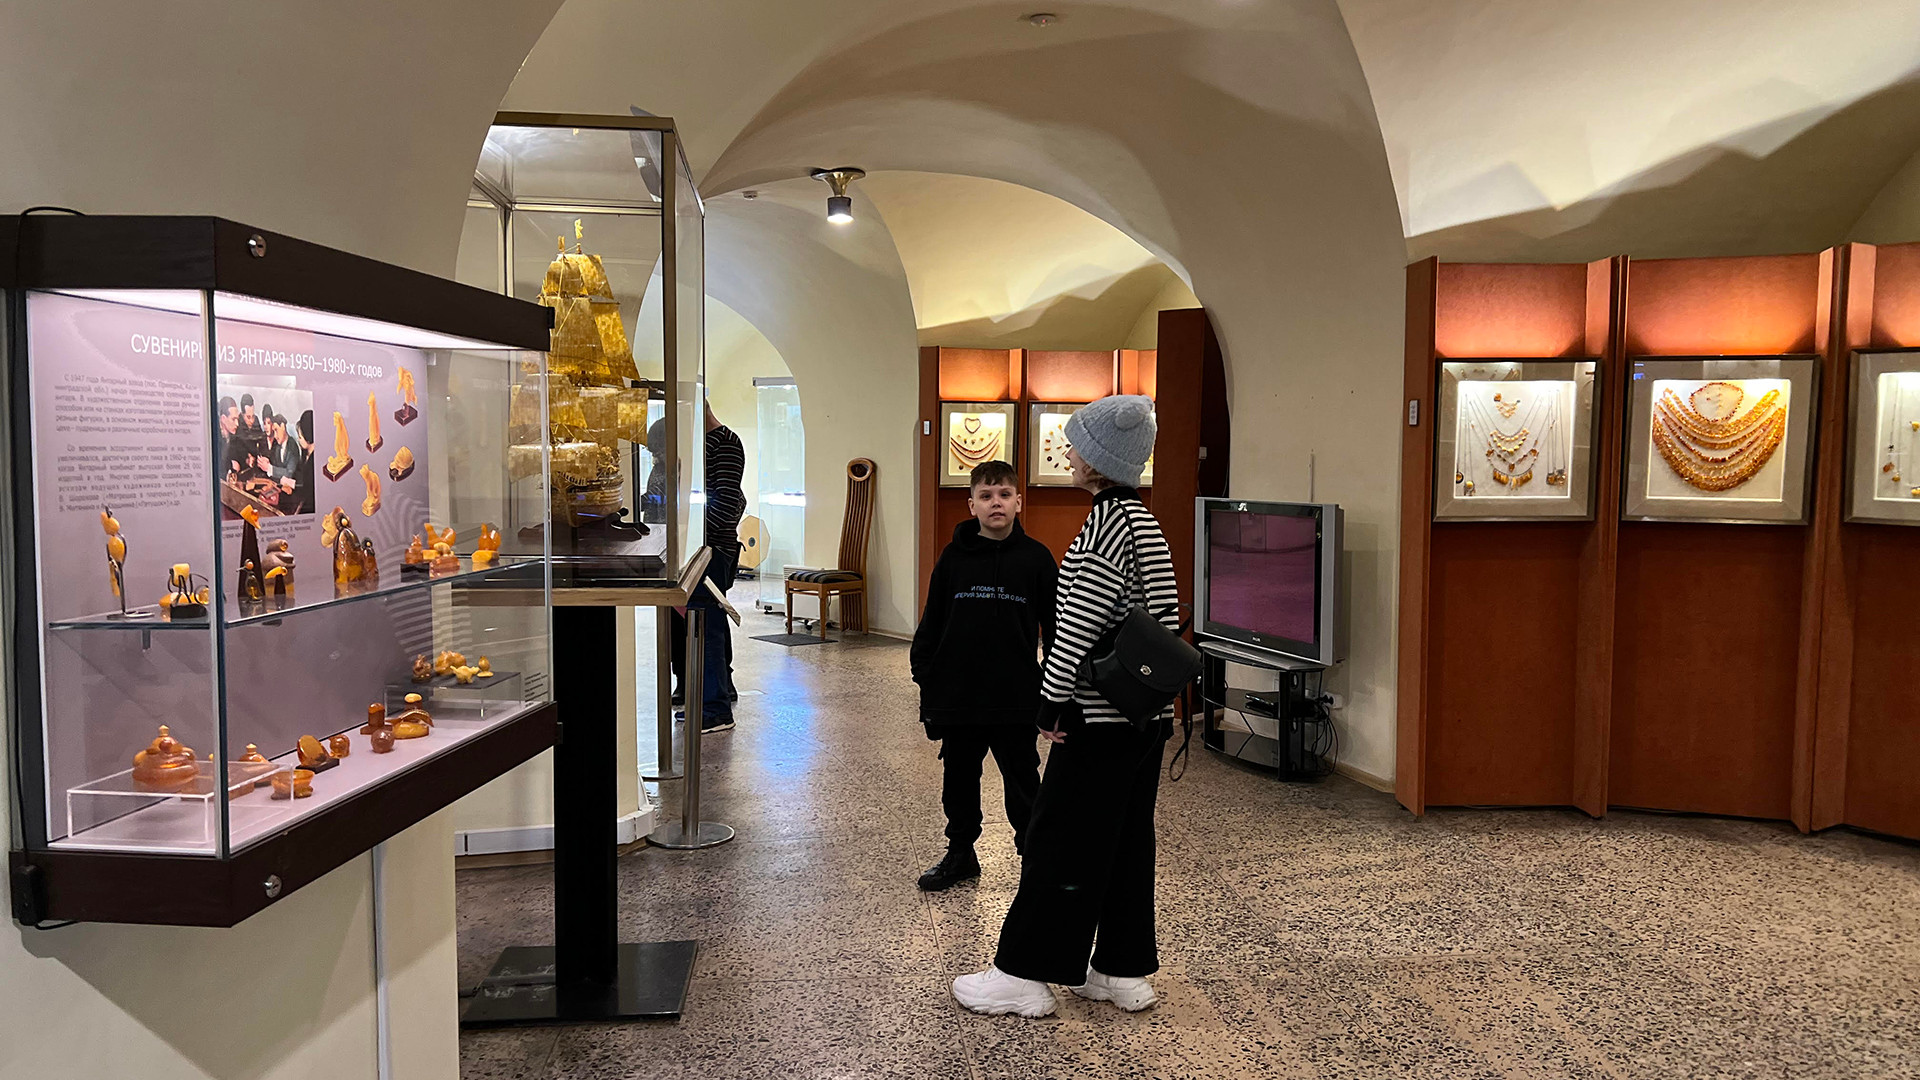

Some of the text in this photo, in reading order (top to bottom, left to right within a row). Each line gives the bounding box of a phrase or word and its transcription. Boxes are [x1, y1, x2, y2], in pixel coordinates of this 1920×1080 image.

[218, 344, 236, 362] ИЗ
[240, 347, 286, 368] ЯНТАРЯ
[358, 364, 382, 378] годов
